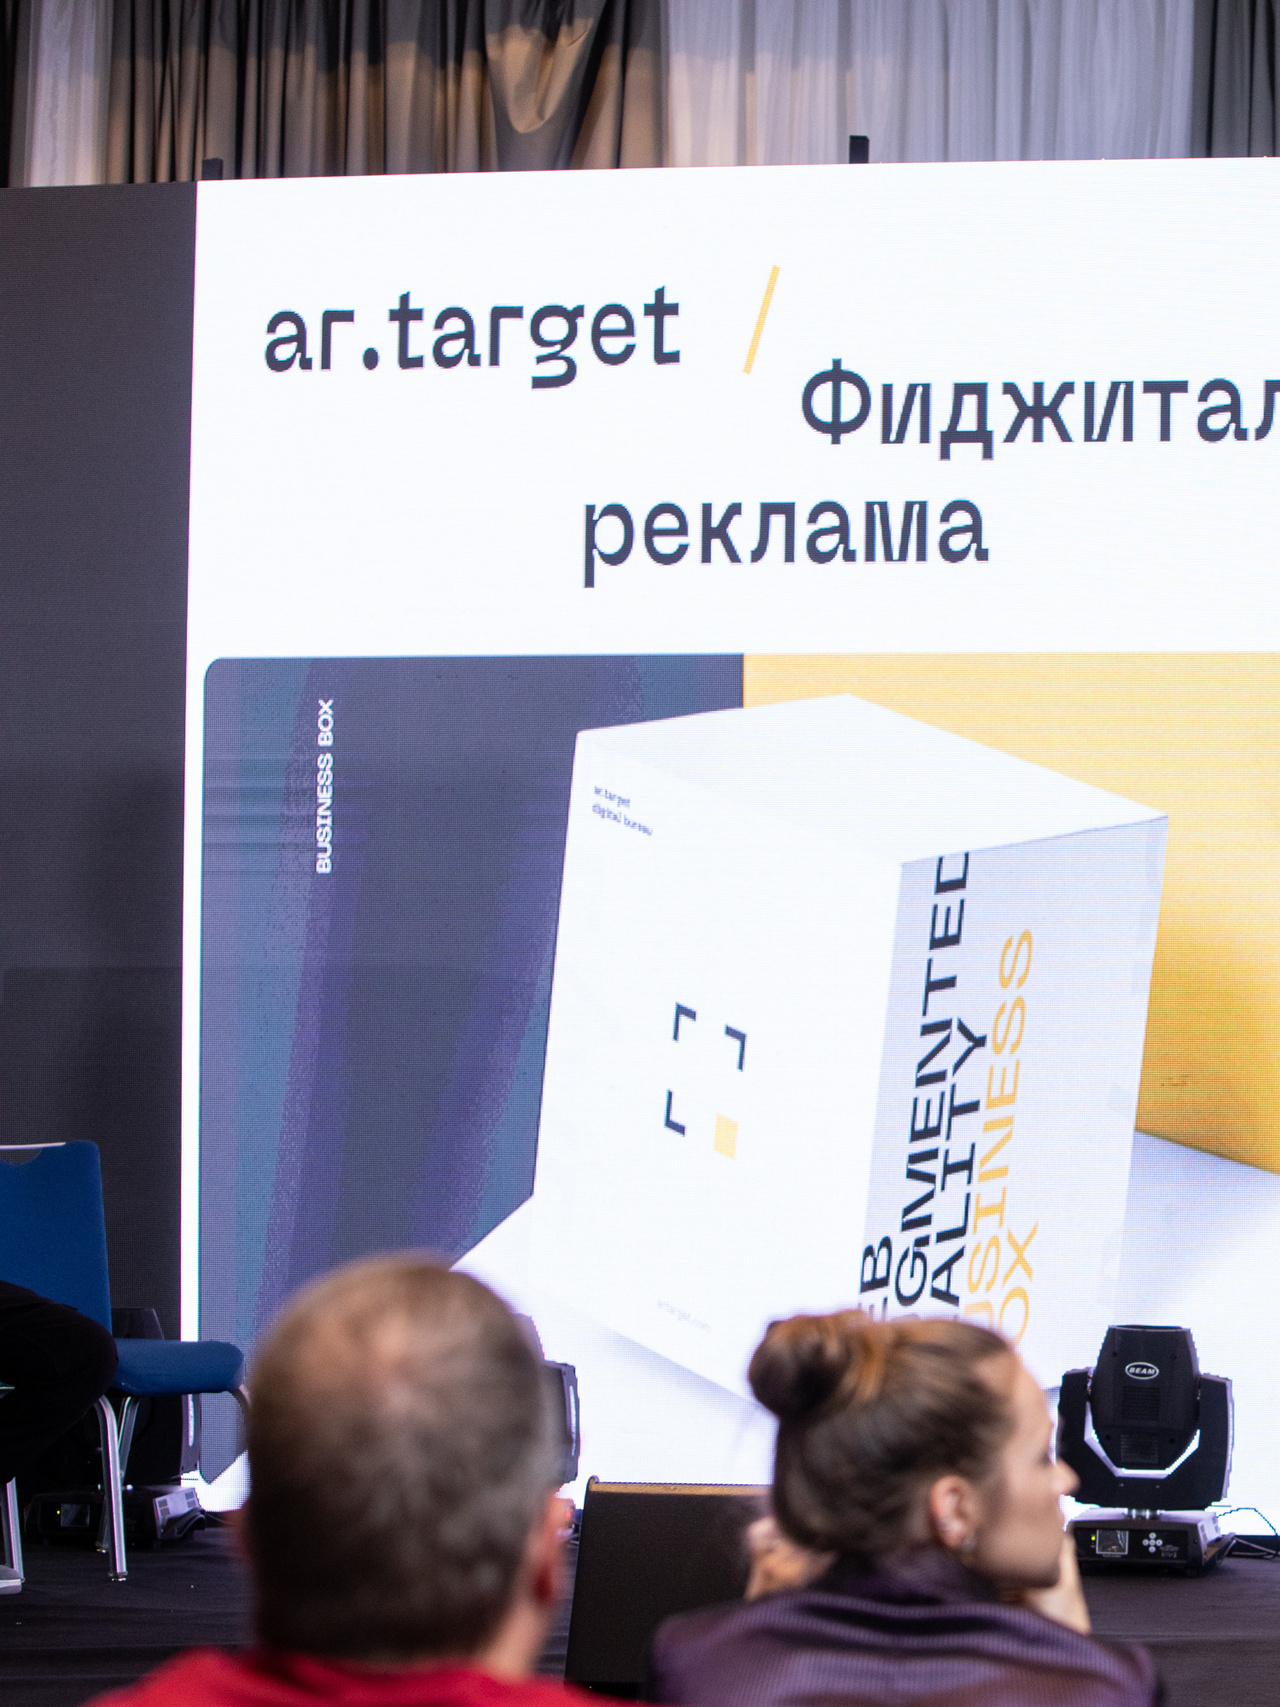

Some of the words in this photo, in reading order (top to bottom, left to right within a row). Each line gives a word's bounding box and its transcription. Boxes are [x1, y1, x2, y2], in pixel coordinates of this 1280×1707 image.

[264, 284, 681, 390] ar.target
[583, 498, 990, 589] реклама
[317, 698, 334, 747] BOX
[316, 752, 334, 874] BUSINESS
[930, 1016, 988, 1312] ALITY
[1128, 1366, 1156, 1375] BEAM
